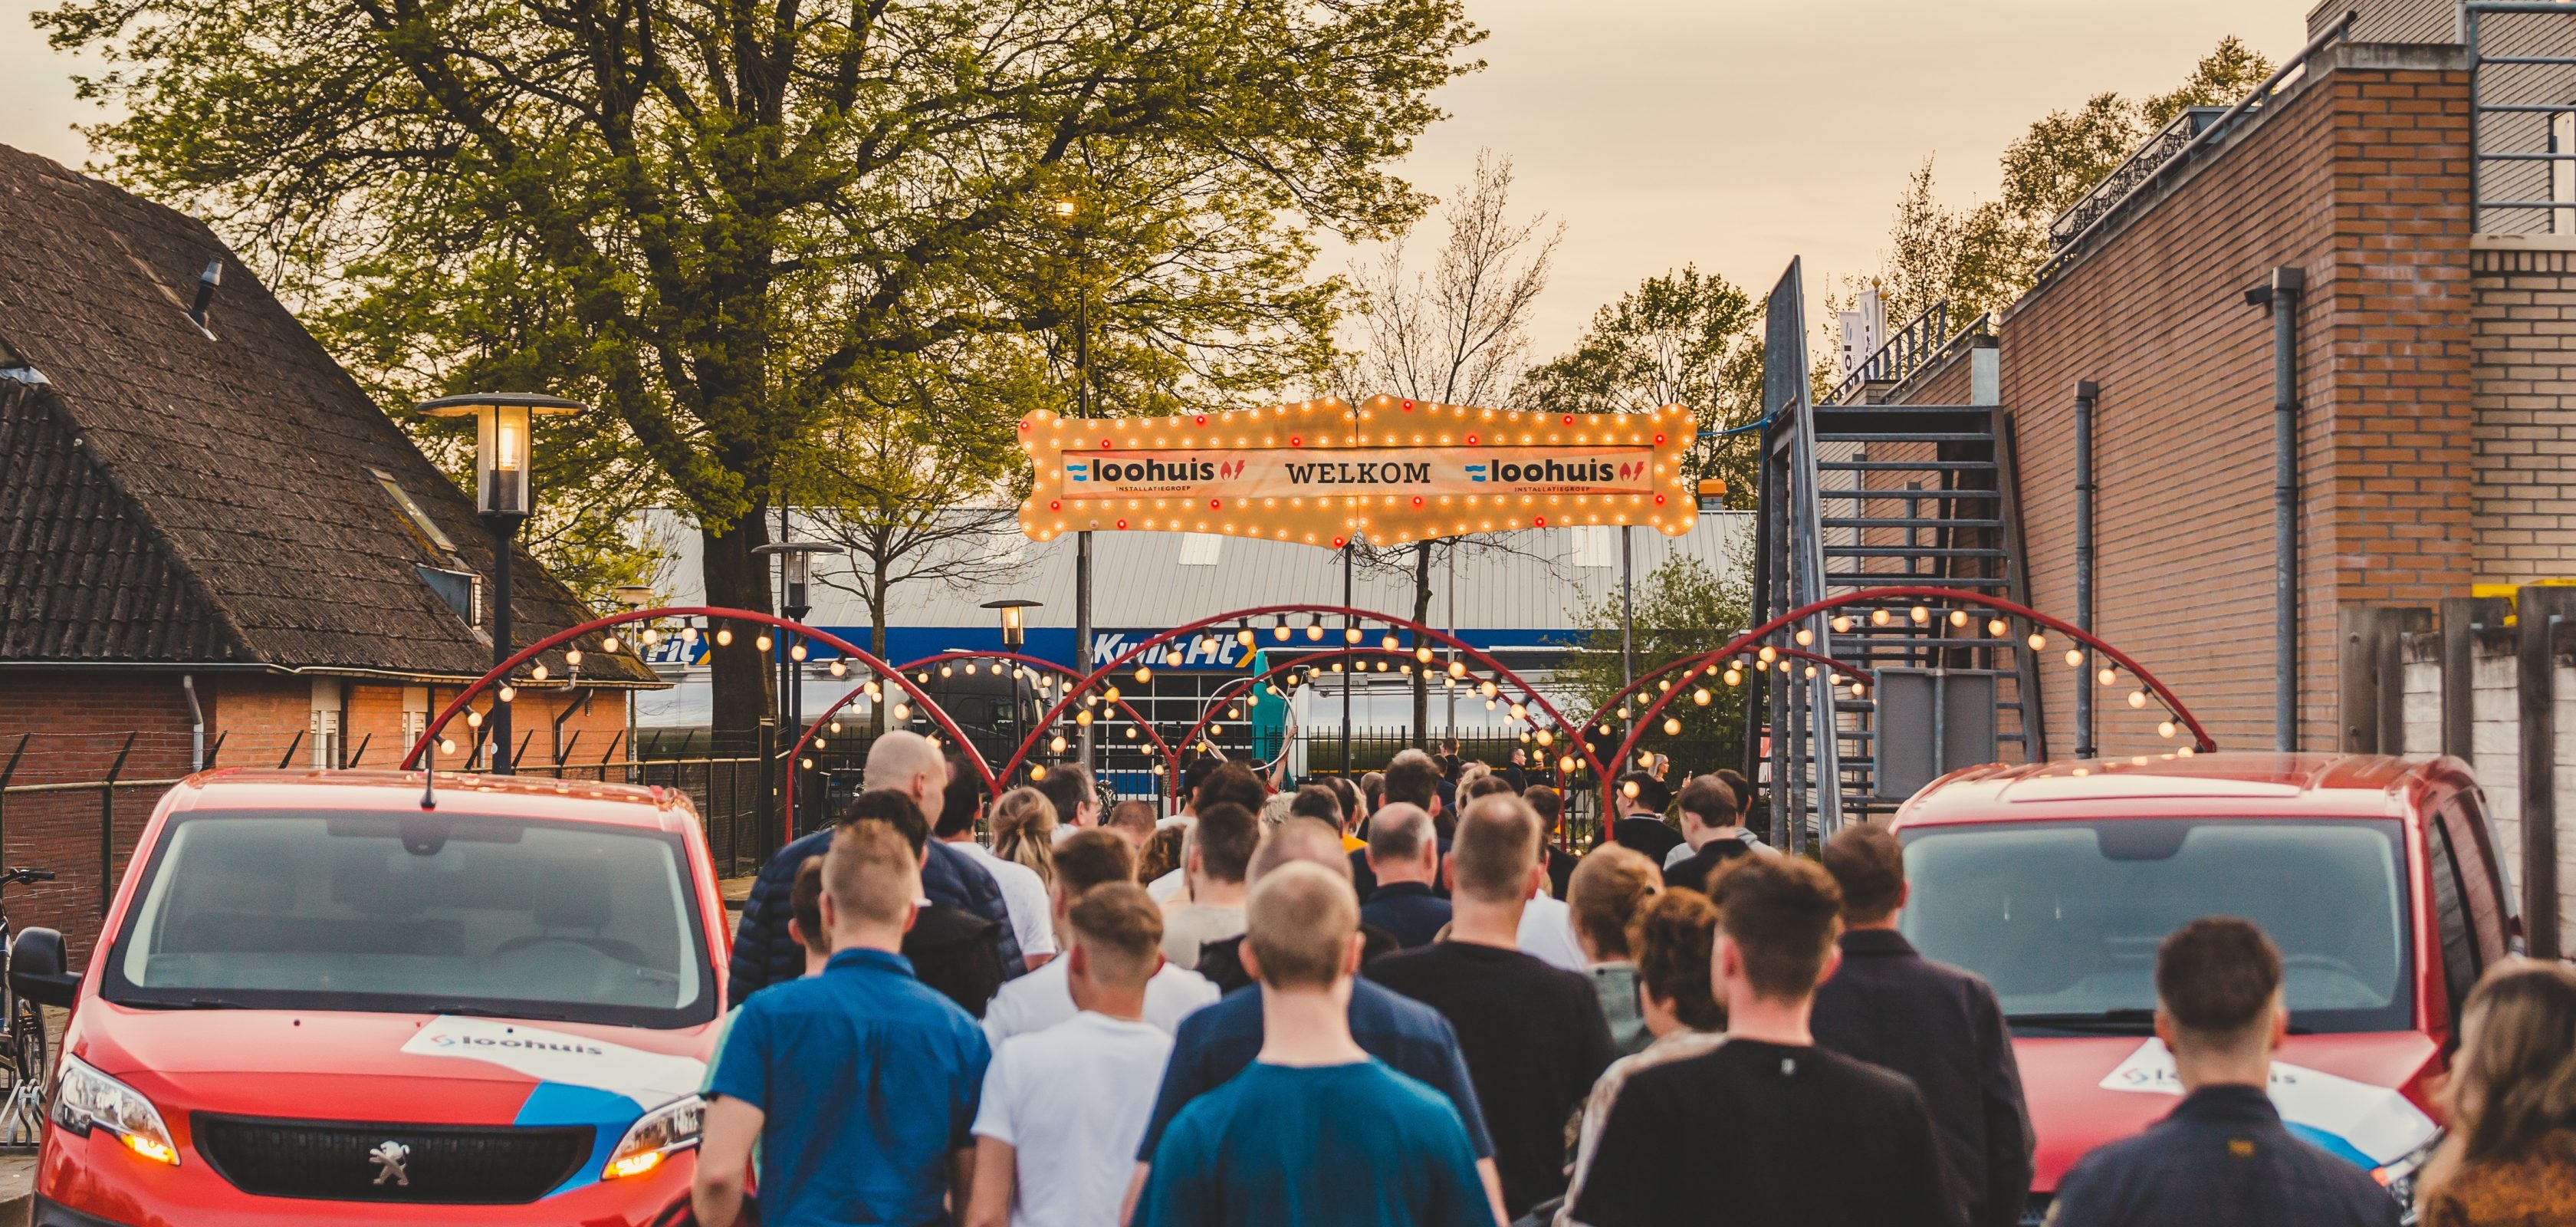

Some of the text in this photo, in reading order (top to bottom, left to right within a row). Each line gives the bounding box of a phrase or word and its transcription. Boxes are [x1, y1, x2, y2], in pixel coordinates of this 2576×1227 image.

[1092, 457, 1214, 482] loohuis
[1285, 462, 1431, 484] WELKOM
[1491, 458, 1614, 482] loohuis
[1184, 633, 1238, 664] Fit
[462, 1036, 603, 1054] loohuis
